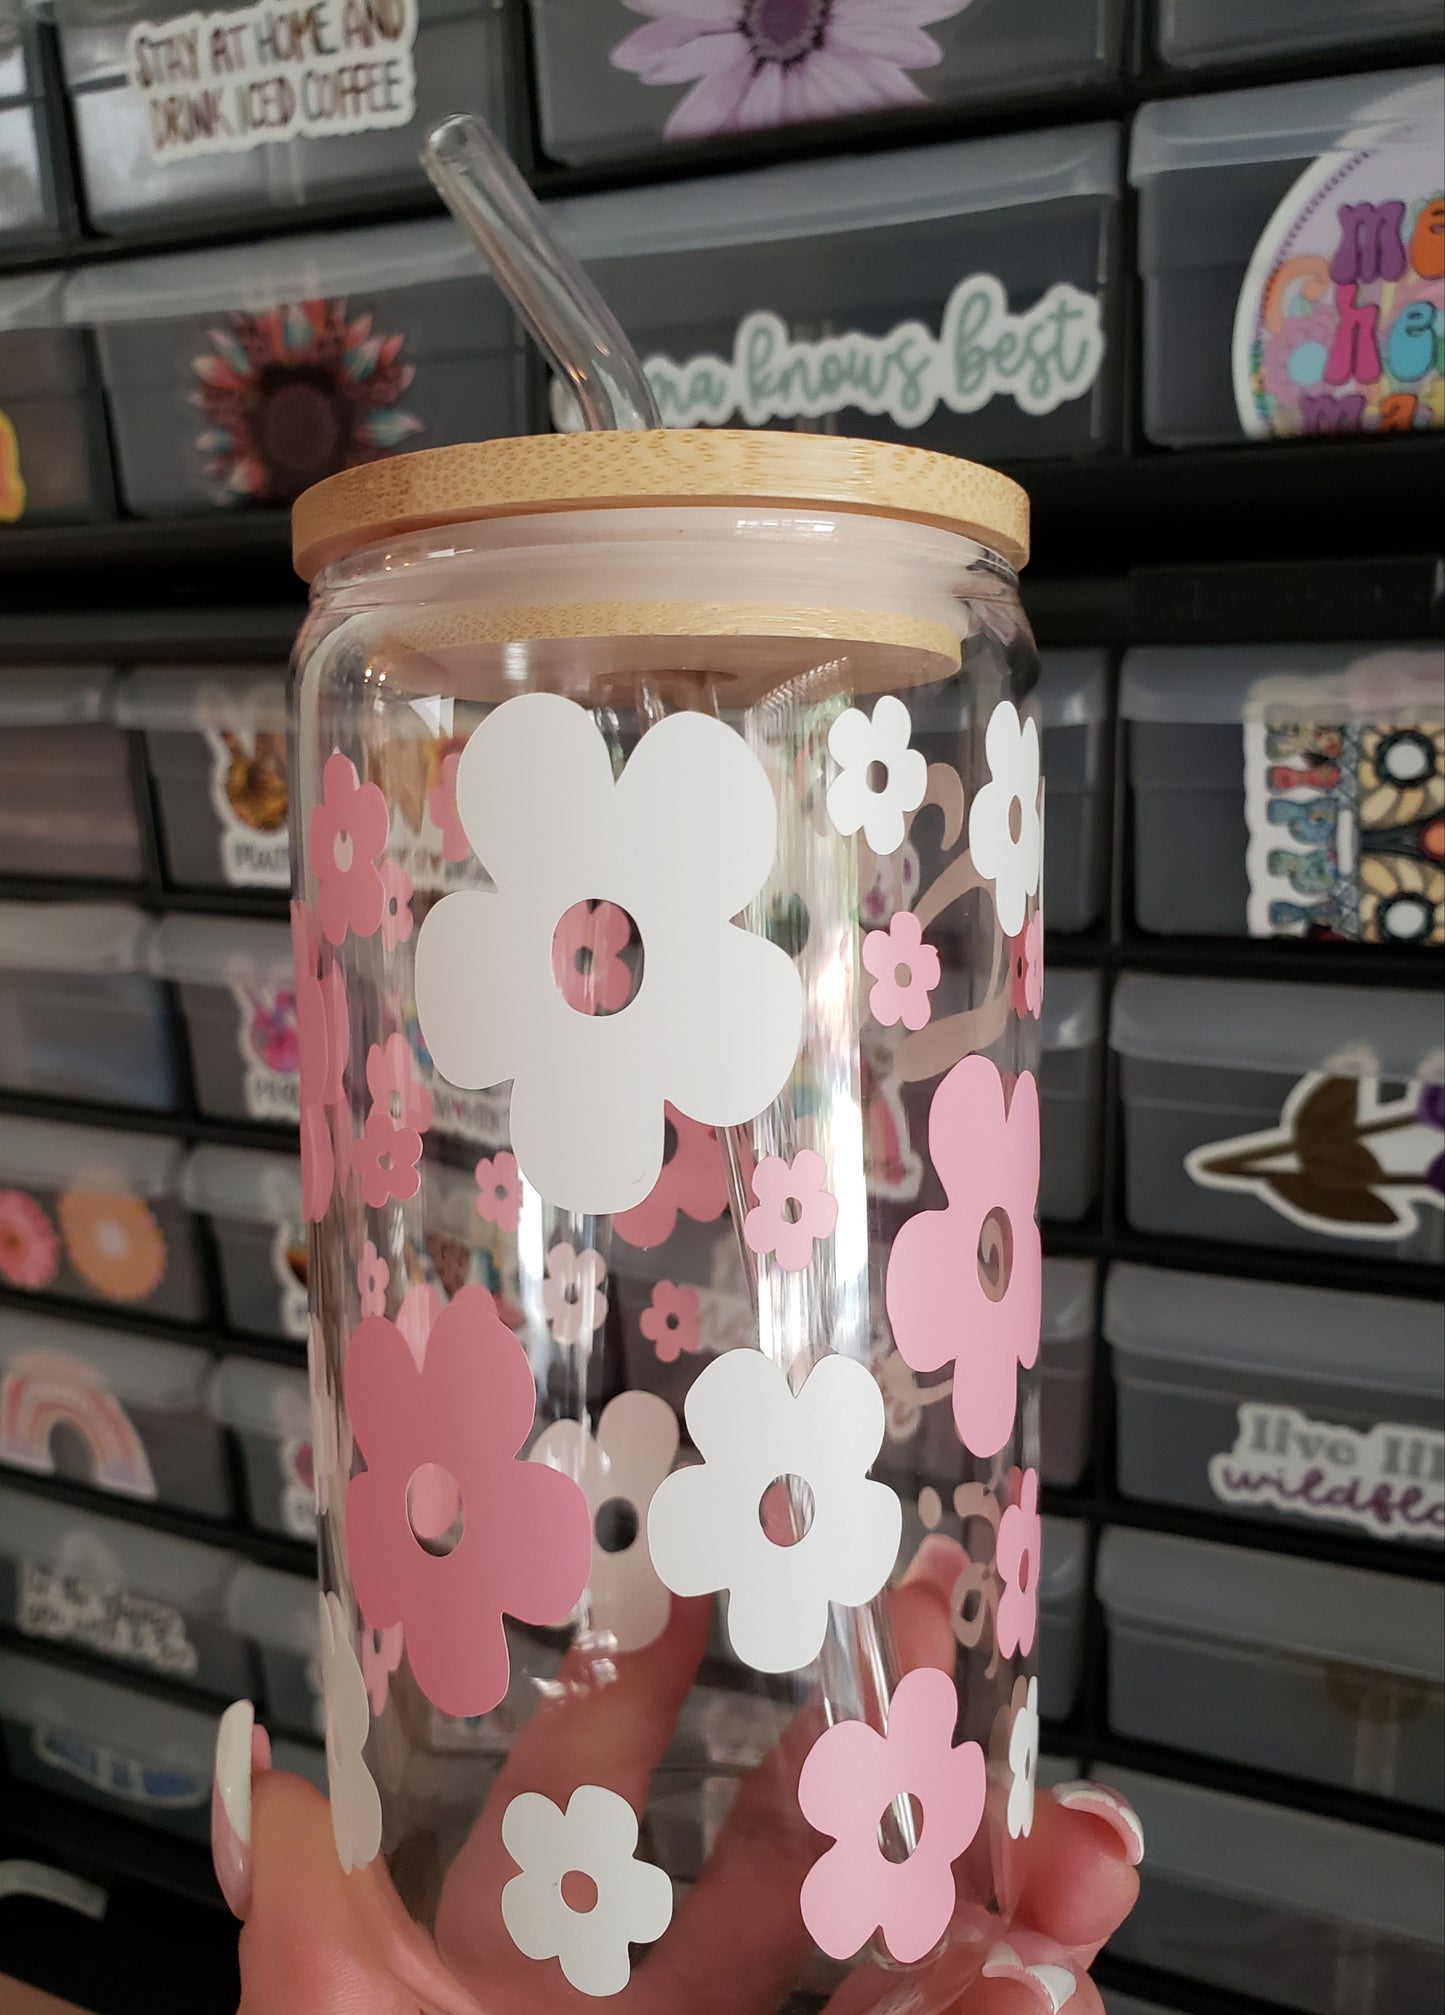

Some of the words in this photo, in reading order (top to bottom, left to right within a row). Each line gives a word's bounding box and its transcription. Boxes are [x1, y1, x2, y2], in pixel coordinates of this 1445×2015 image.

[135, 26, 199, 88] STAY
[210, 24, 248, 76] AT
[253, 1, 338, 63] HOME
[150, 88, 236, 150] DRINK
[236, 76, 297, 134] ICED
[302, 59, 400, 121] COFFEE
[746, 325, 931, 411] knows
[957, 292, 1088, 397] best
